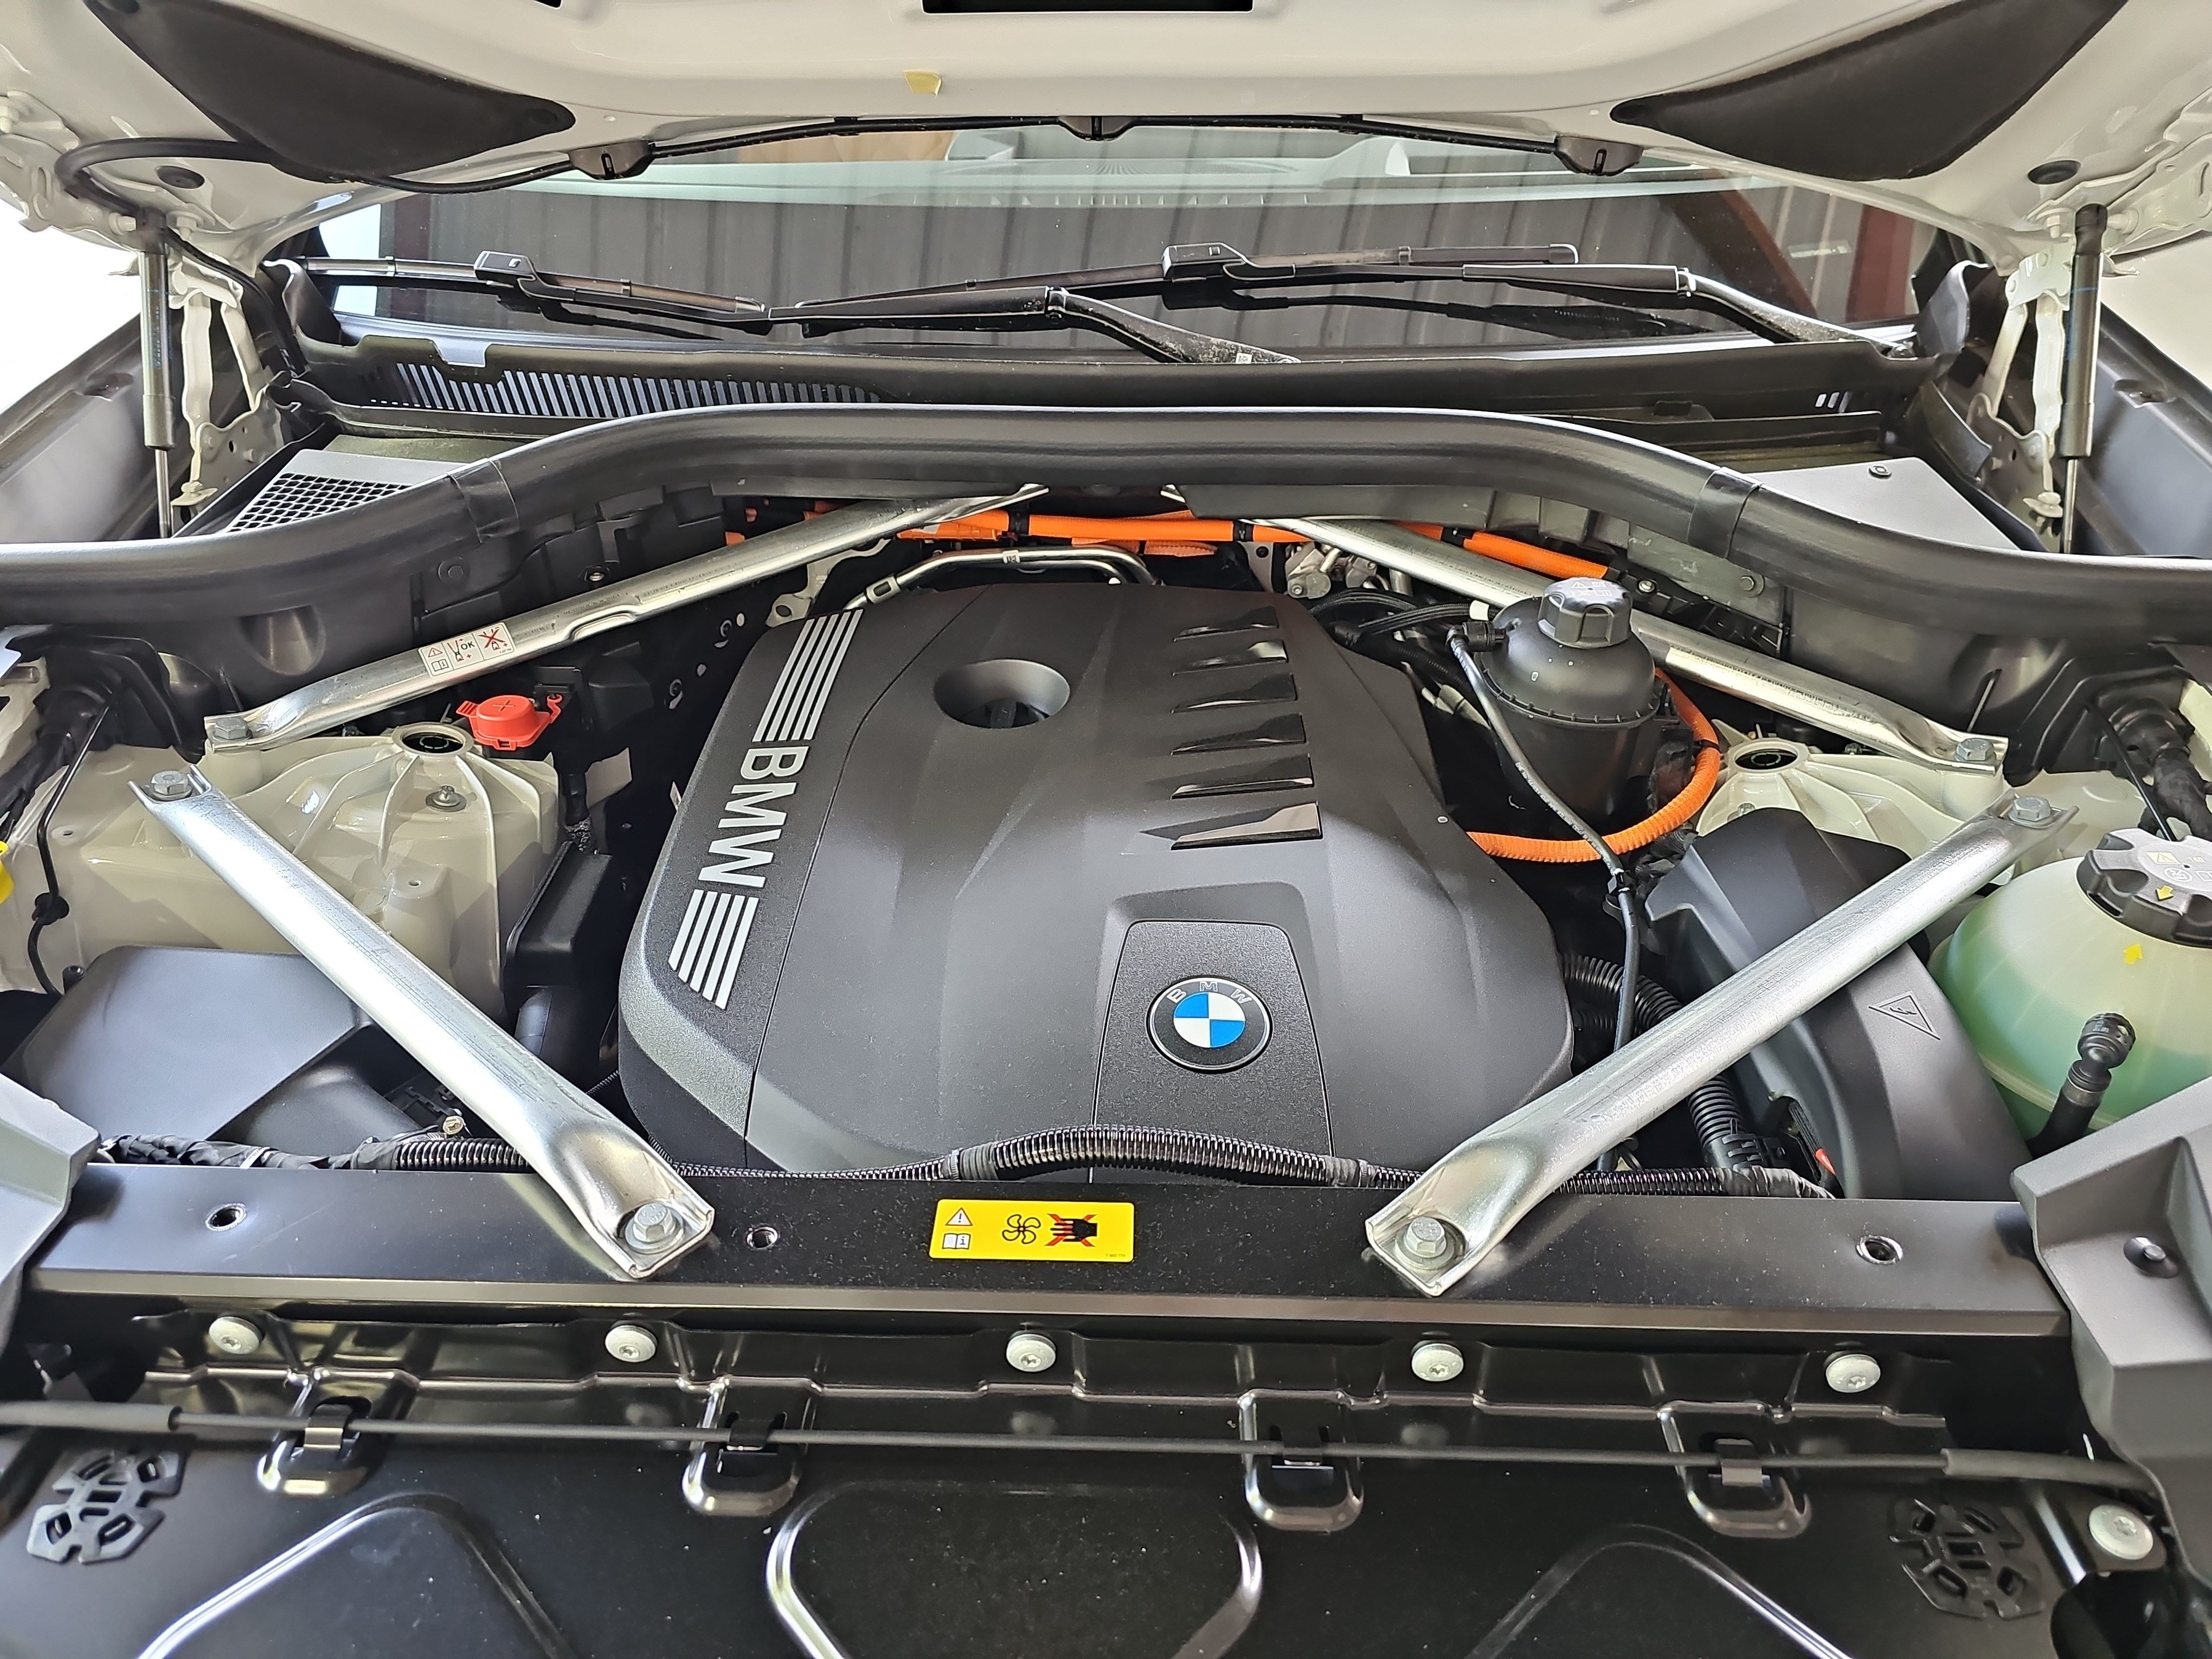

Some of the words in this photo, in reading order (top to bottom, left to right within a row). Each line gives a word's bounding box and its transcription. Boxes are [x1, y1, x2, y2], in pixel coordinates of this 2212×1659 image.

[461, 641, 475, 651] OK
[698, 745, 809, 889] BMW
[1167, 981, 1252, 1005] BMW
